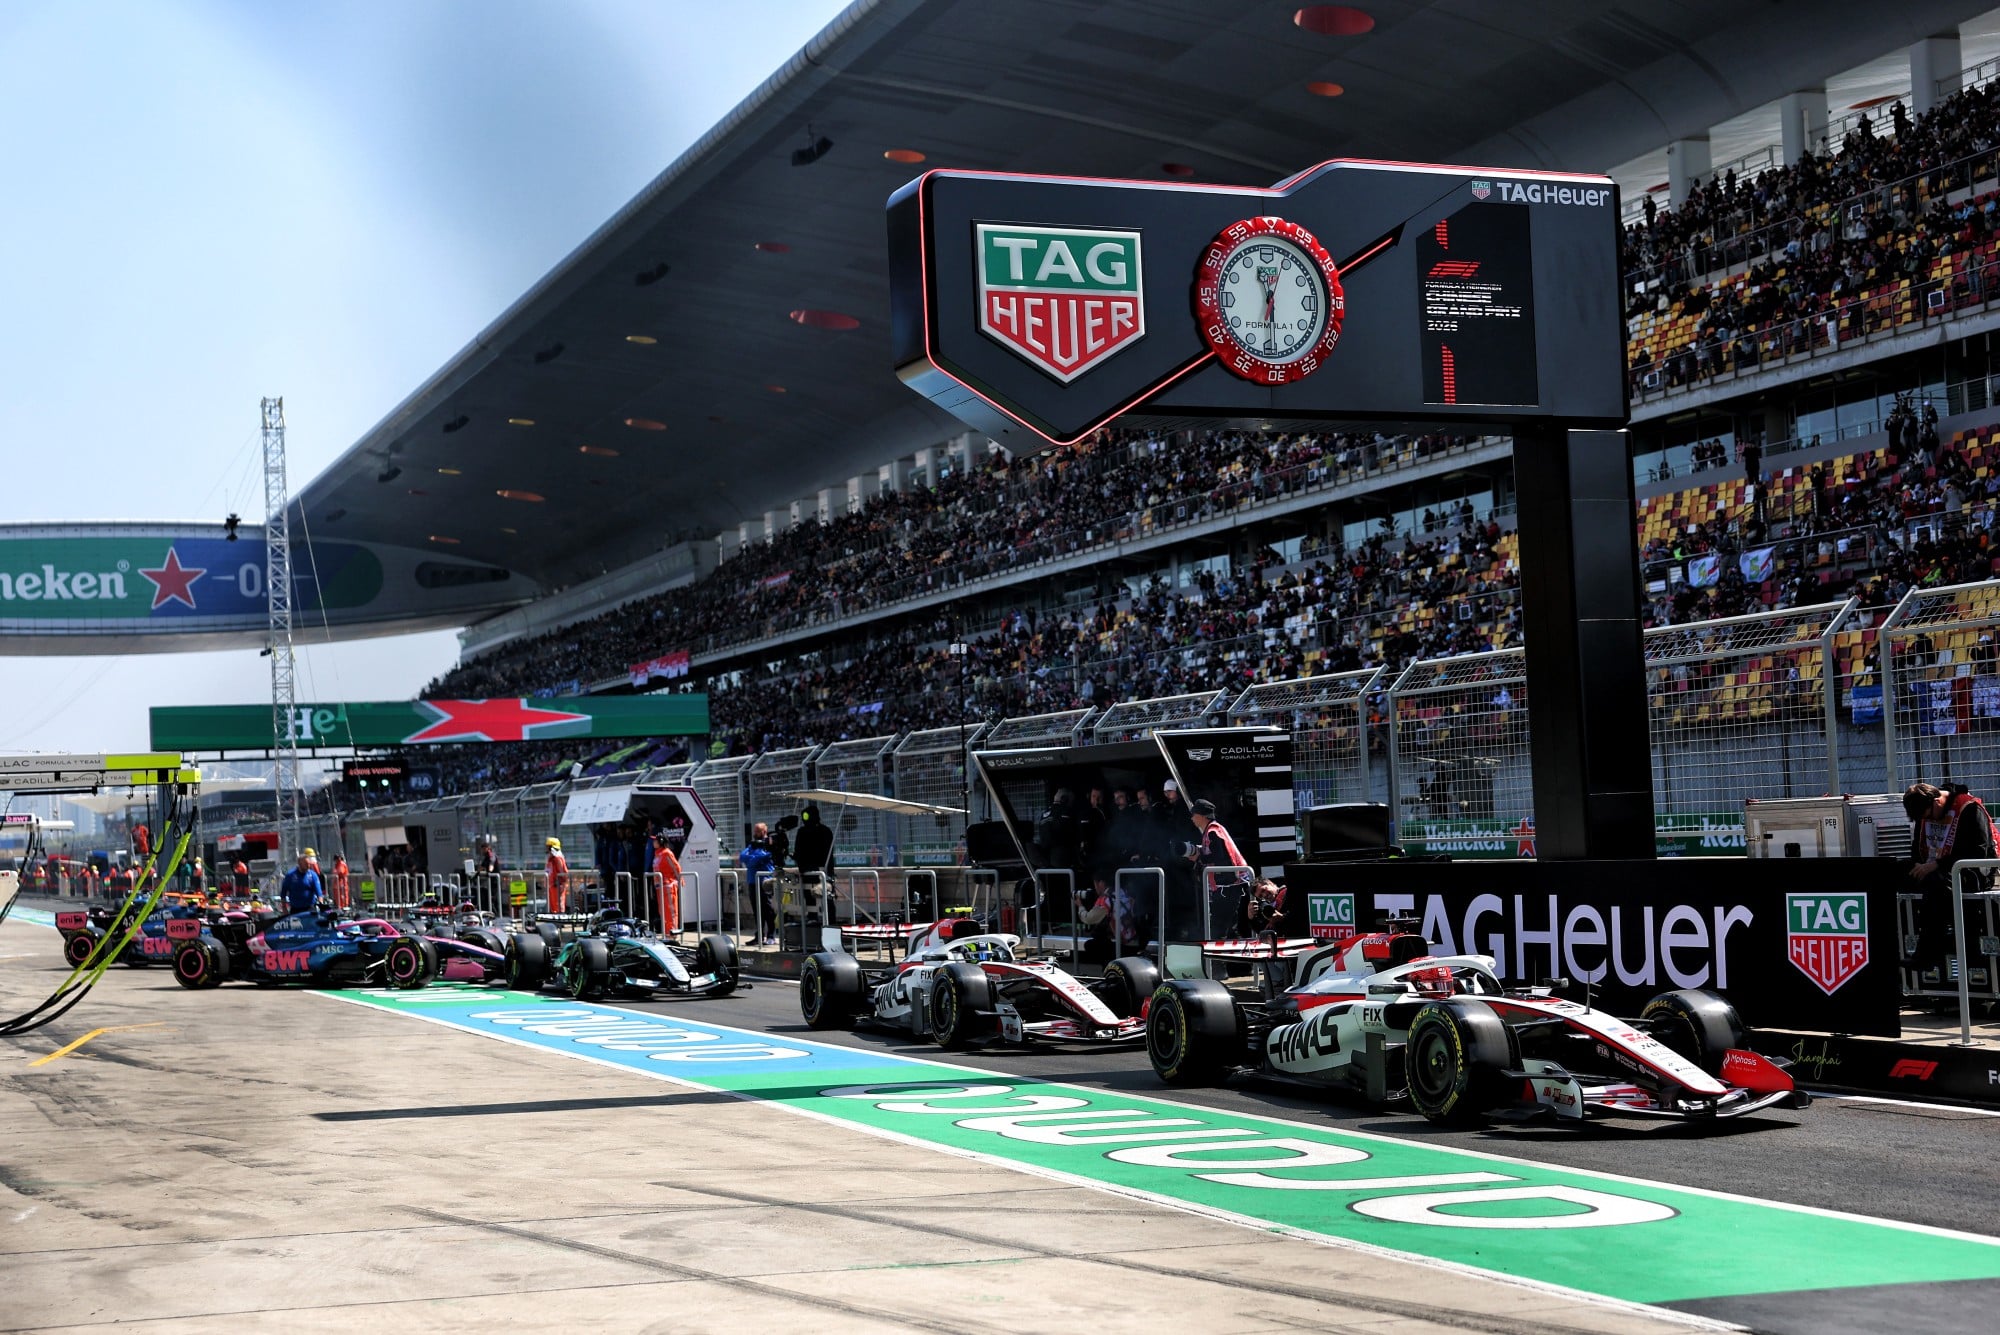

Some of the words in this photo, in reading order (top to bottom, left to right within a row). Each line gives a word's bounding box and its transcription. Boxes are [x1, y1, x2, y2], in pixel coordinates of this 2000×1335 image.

[1497, 182, 1609, 206] TAGHeuer
[1228, 224, 1247, 239] 55
[1296, 228, 1312, 244] 05
[993, 237, 1127, 284] TAG
[1206, 248, 1221, 268] 50
[1324, 256, 1335, 272] 10
[1201, 287, 1212, 306] 45
[1336, 296, 1344, 309] 15
[1427, 304, 1483, 318] GRAND
[1485, 305, 1522, 318] PRIX
[992, 296, 1134, 367] HEUER
[1208, 325, 1224, 343] 40
[1245, 321, 1288, 330] FORMLA
[1326, 330, 1339, 350] 20
[1234, 356, 1252, 373] 35
[1302, 360, 1318, 375] 25
[1268, 371, 1286, 382] 30
[1221, 745, 1274, 754] CADILLAC
[1424, 824, 1507, 851] Heineken
[1312, 898, 1351, 921] TAG
[1793, 899, 1860, 931] TAG
[170, 924, 185, 934] eni
[321, 945, 345, 954] MSC
[1374, 894, 1754, 989] TAGHeuer
[265, 951, 312, 971] BWT
[1793, 938, 1865, 985] HEUER
[920, 970, 933, 980] FIX
[1363, 1008, 1382, 1022] FIX
